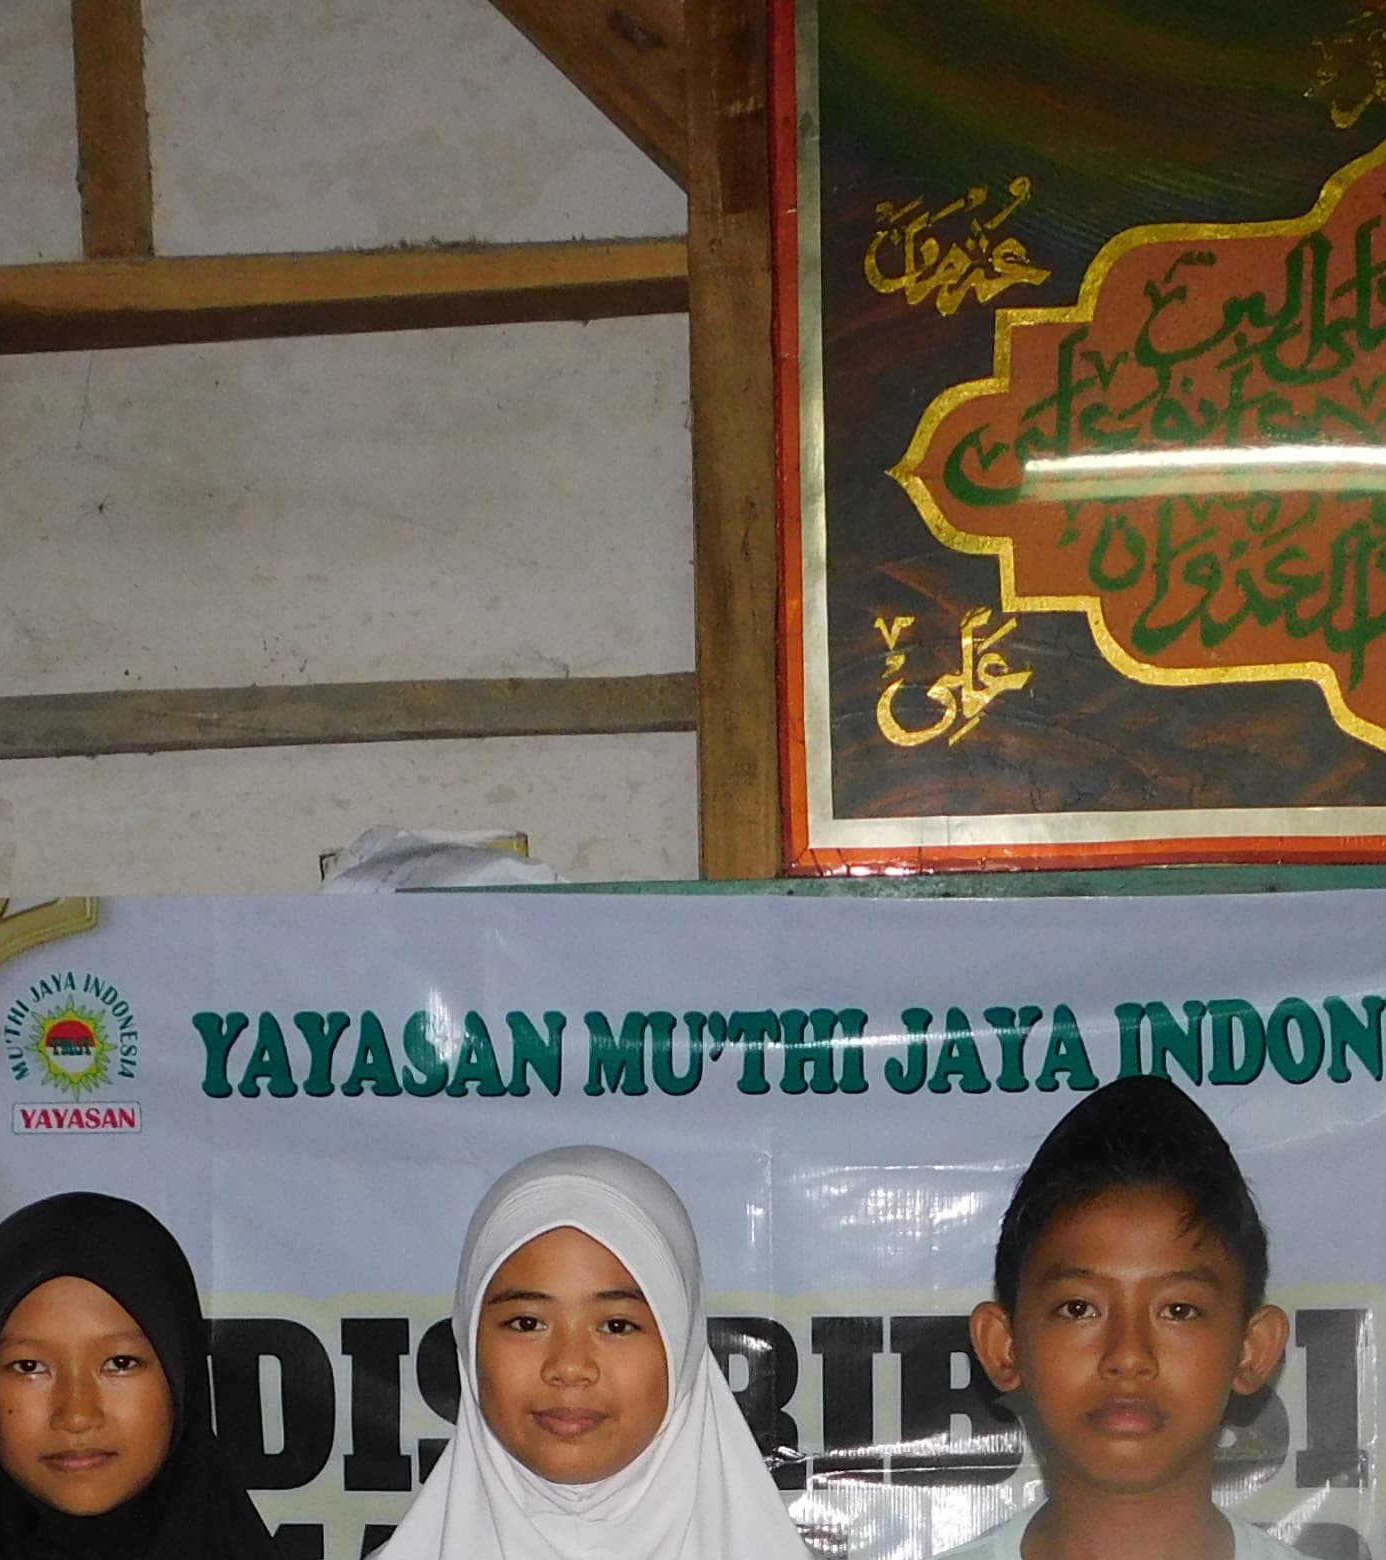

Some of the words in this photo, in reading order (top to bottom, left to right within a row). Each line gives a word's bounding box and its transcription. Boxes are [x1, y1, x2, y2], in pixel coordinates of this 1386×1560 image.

[30, 971, 76, 1003] JAYA
[83, 973, 139, 1080] INDONESIA
[192, 1009, 567, 1099] YAYASAN
[583, 1008, 870, 1097] MU'THI
[884, 1003, 1099, 1095] JAYA
[20, 1107, 136, 1129] YAYASAN
